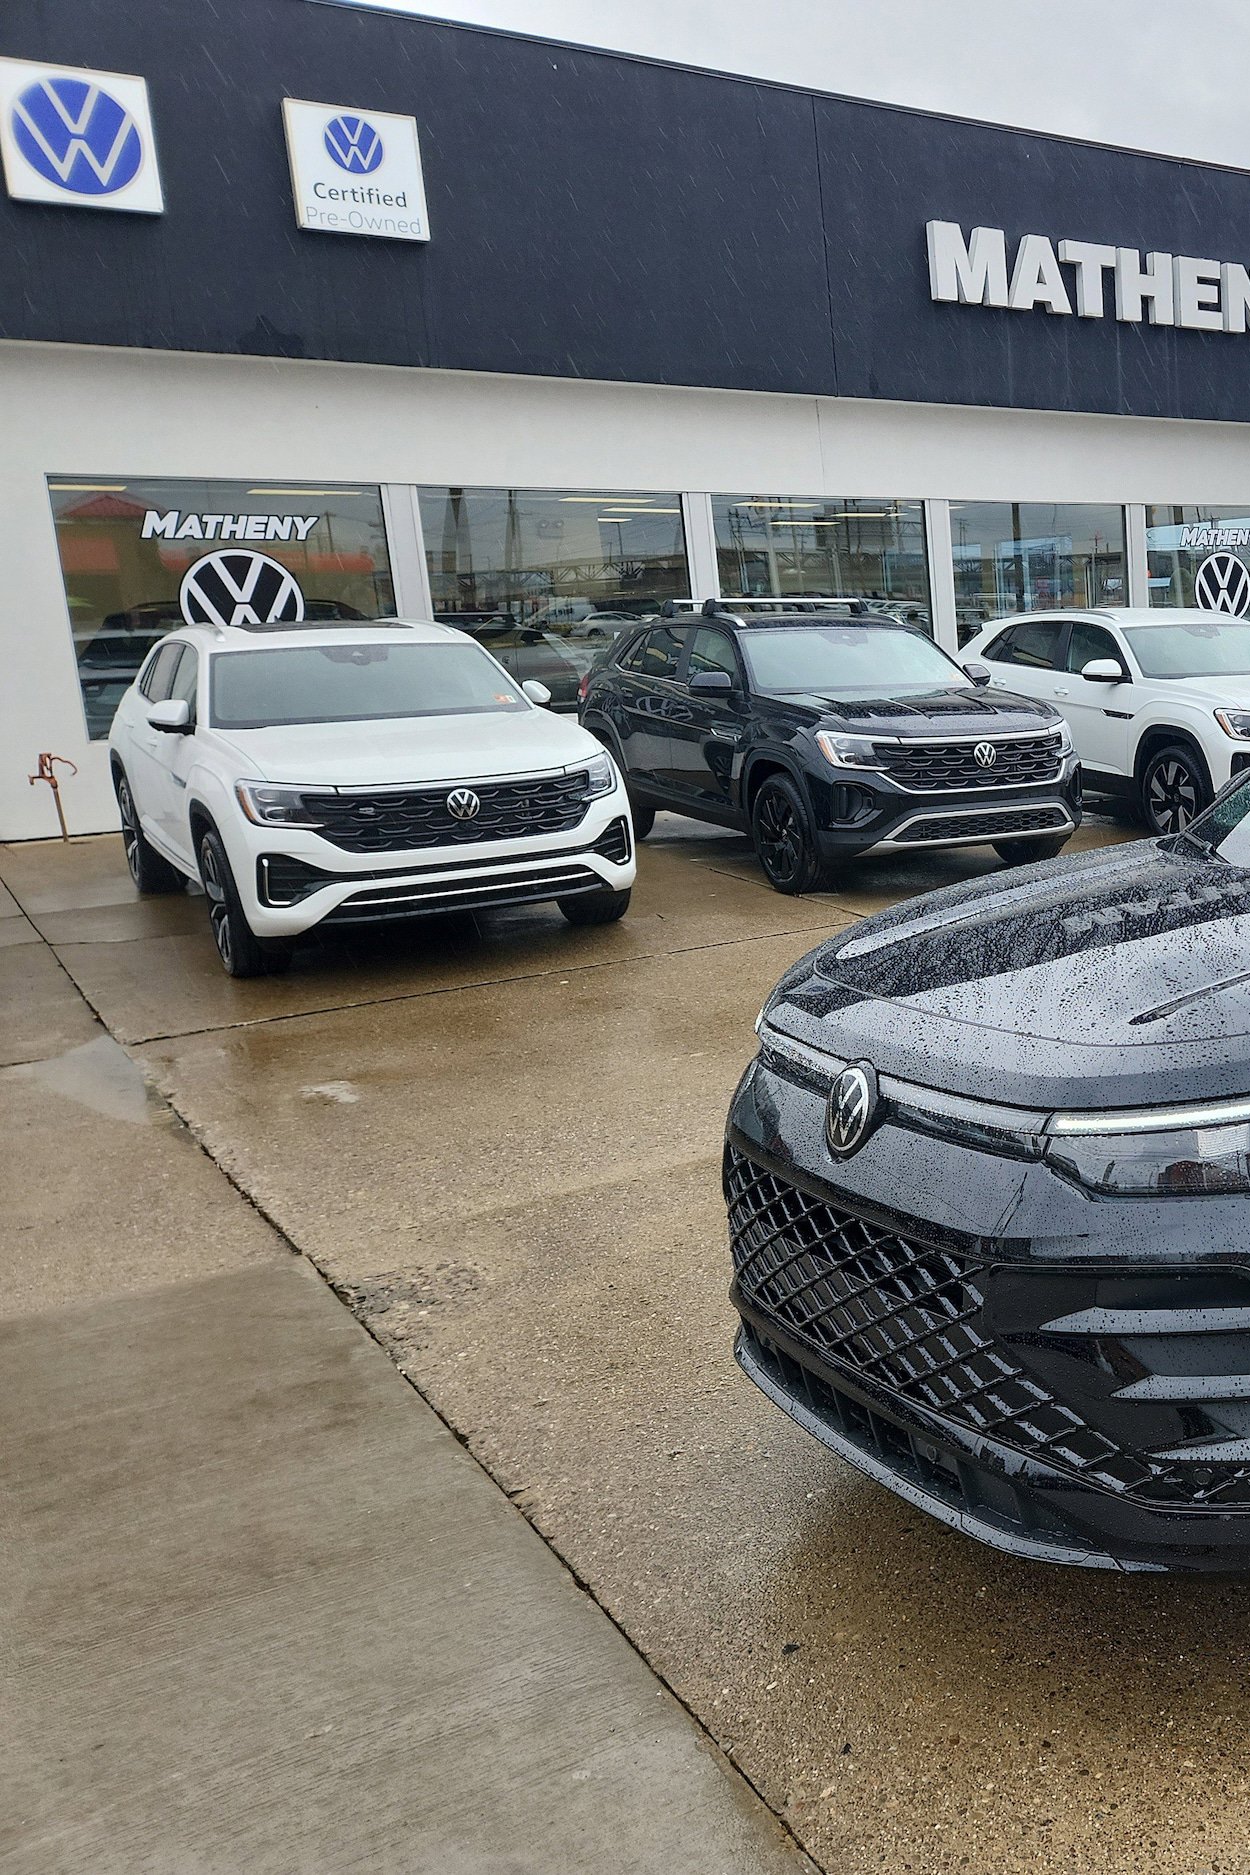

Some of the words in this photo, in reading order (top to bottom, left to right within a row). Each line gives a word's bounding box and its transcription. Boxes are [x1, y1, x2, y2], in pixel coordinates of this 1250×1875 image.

[313, 182, 408, 208] Certified
[306, 206, 421, 235] Pre-Owned
[140, 509, 320, 541] MATHENY
